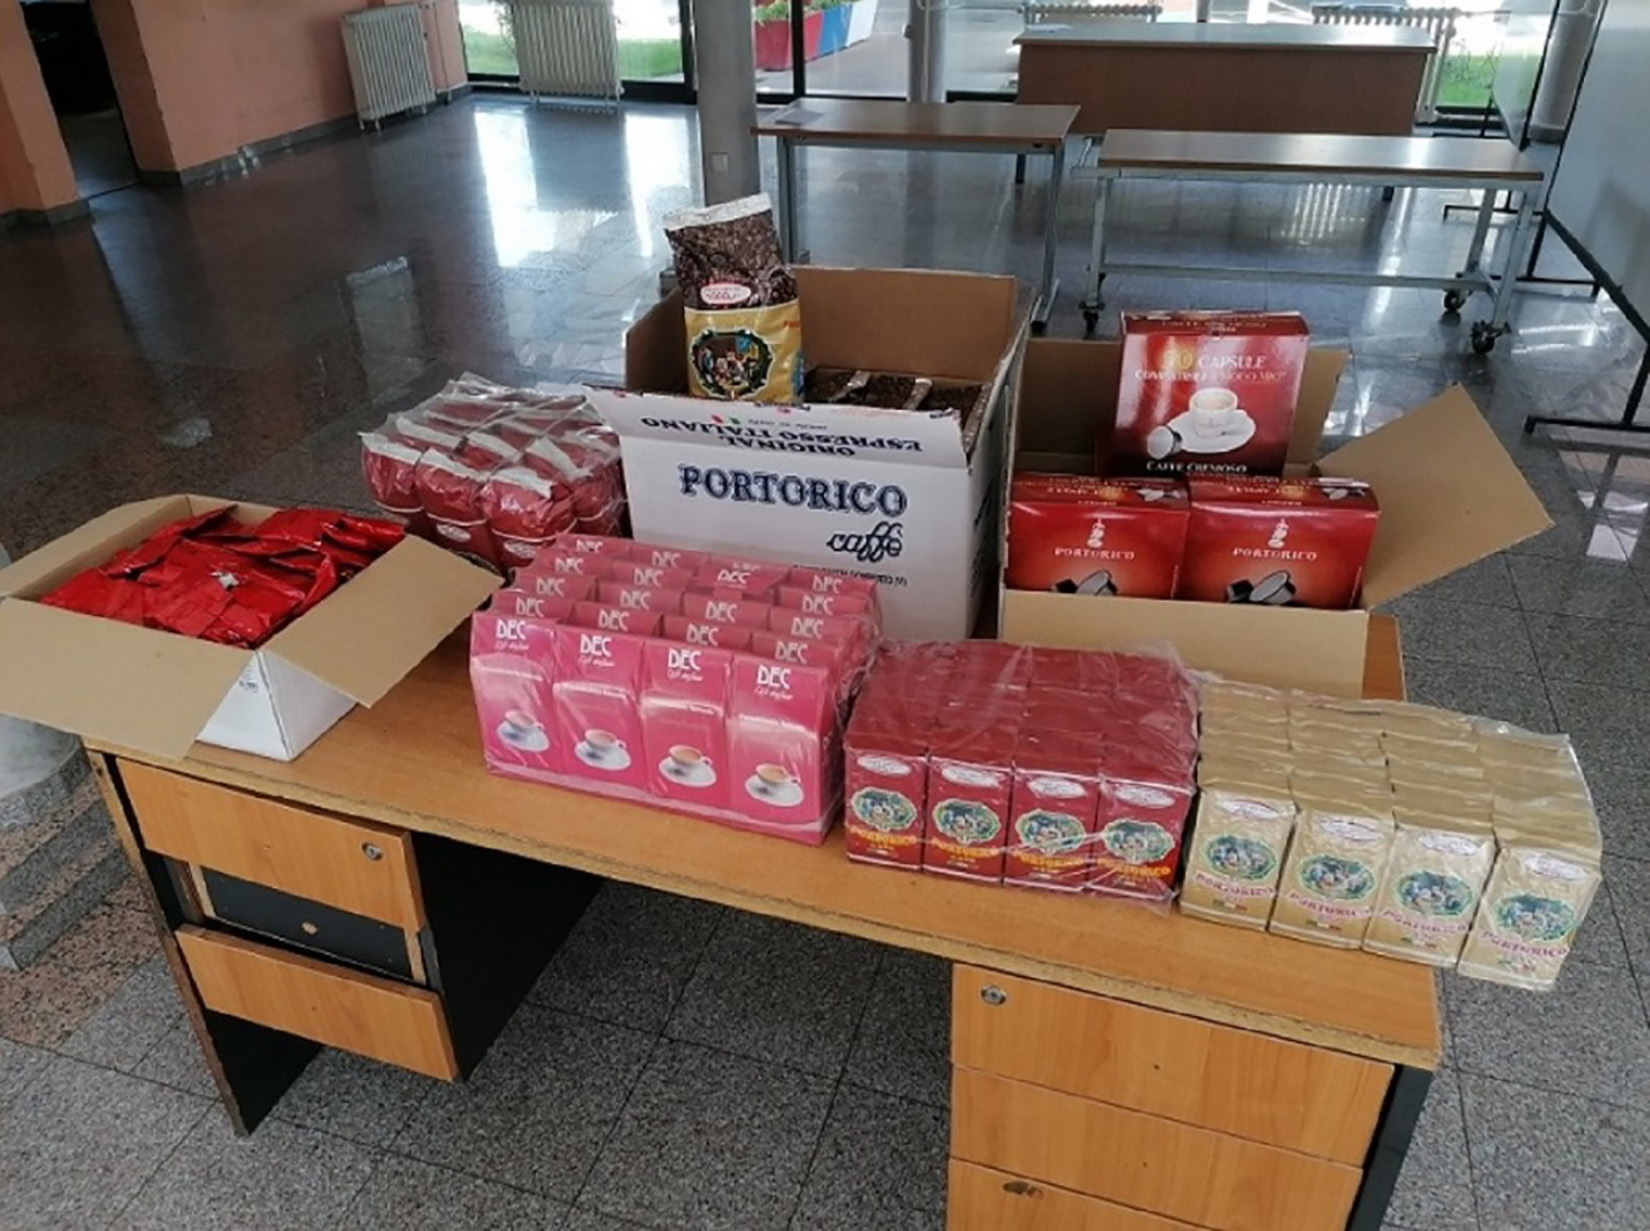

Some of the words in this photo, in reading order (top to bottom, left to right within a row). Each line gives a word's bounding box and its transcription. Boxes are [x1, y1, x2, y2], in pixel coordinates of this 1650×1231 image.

[1198, 355, 1266, 369] CAPSULE
[640, 417, 770, 439] ITALIANO
[719, 436, 856, 457] ORIGINAL
[779, 431, 923, 453] ESPRESSO
[678, 463, 907, 518] PORTORICO
[652, 550, 681, 568] DEC
[1054, 547, 1135, 560] PORTORICO
[1232, 547, 1318, 561] PORTORICO
[555, 558, 584, 575] DEC
[717, 569, 751, 584] DEC
[537, 577, 565, 596] DEC
[633, 568, 664, 587] DEC
[813, 575, 843, 594] DEC
[516, 598, 544, 617] DEC
[620, 590, 651, 610] DEC
[802, 595, 834, 615] DEC
[598, 609, 630, 631] DEC
[706, 600, 738, 623] DEC
[496, 619, 527, 640] DEC
[686, 623, 719, 646] DEC
[791, 617, 824, 639] DEC
[580, 634, 612, 657] DEC
[775, 640, 809, 664] DEC
[668, 647, 702, 670] DEC
[757, 664, 791, 689] DEC
[1289, 892, 1372, 918] PORTORIO
